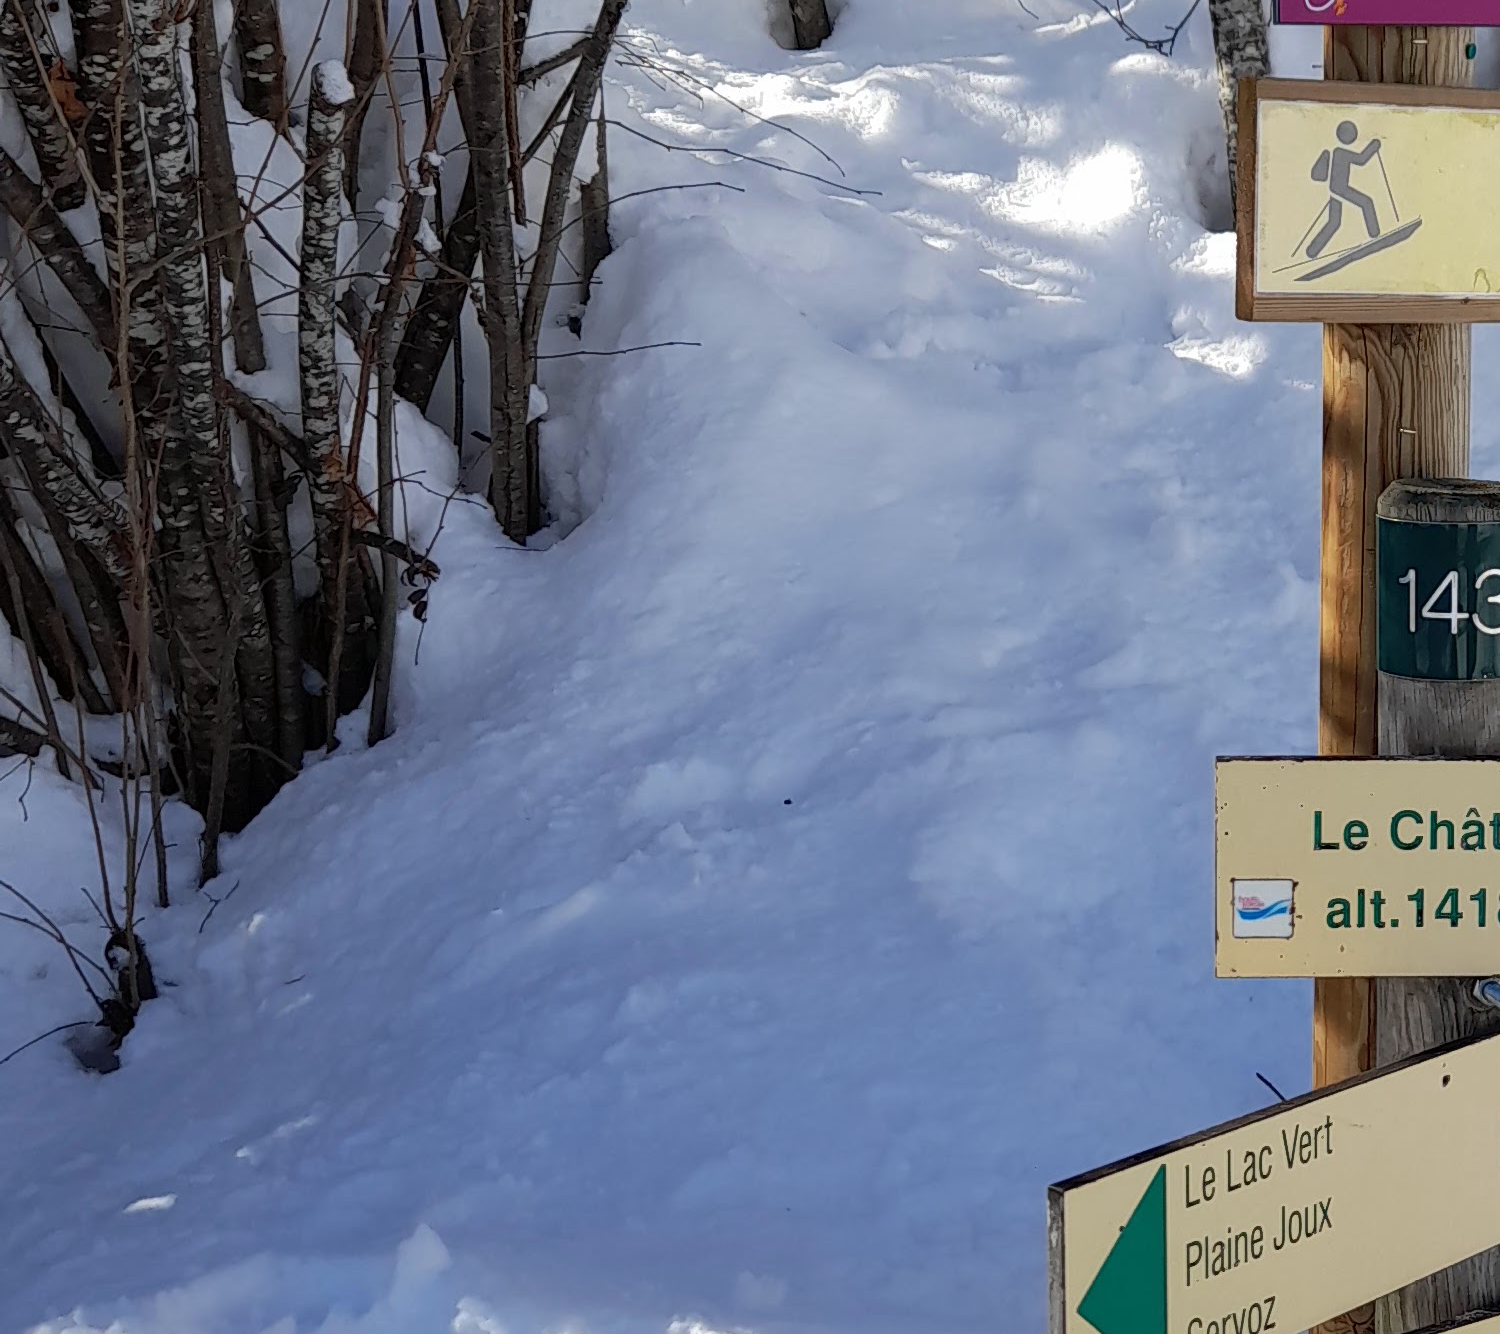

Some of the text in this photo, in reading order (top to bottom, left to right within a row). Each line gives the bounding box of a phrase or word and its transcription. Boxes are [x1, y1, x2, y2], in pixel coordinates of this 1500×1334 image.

[1313, 811, 1369, 850] Le
[1185, 1116, 1333, 1208] Le Lac Vert
[1187, 1198, 1332, 1286] Plaine Joux
